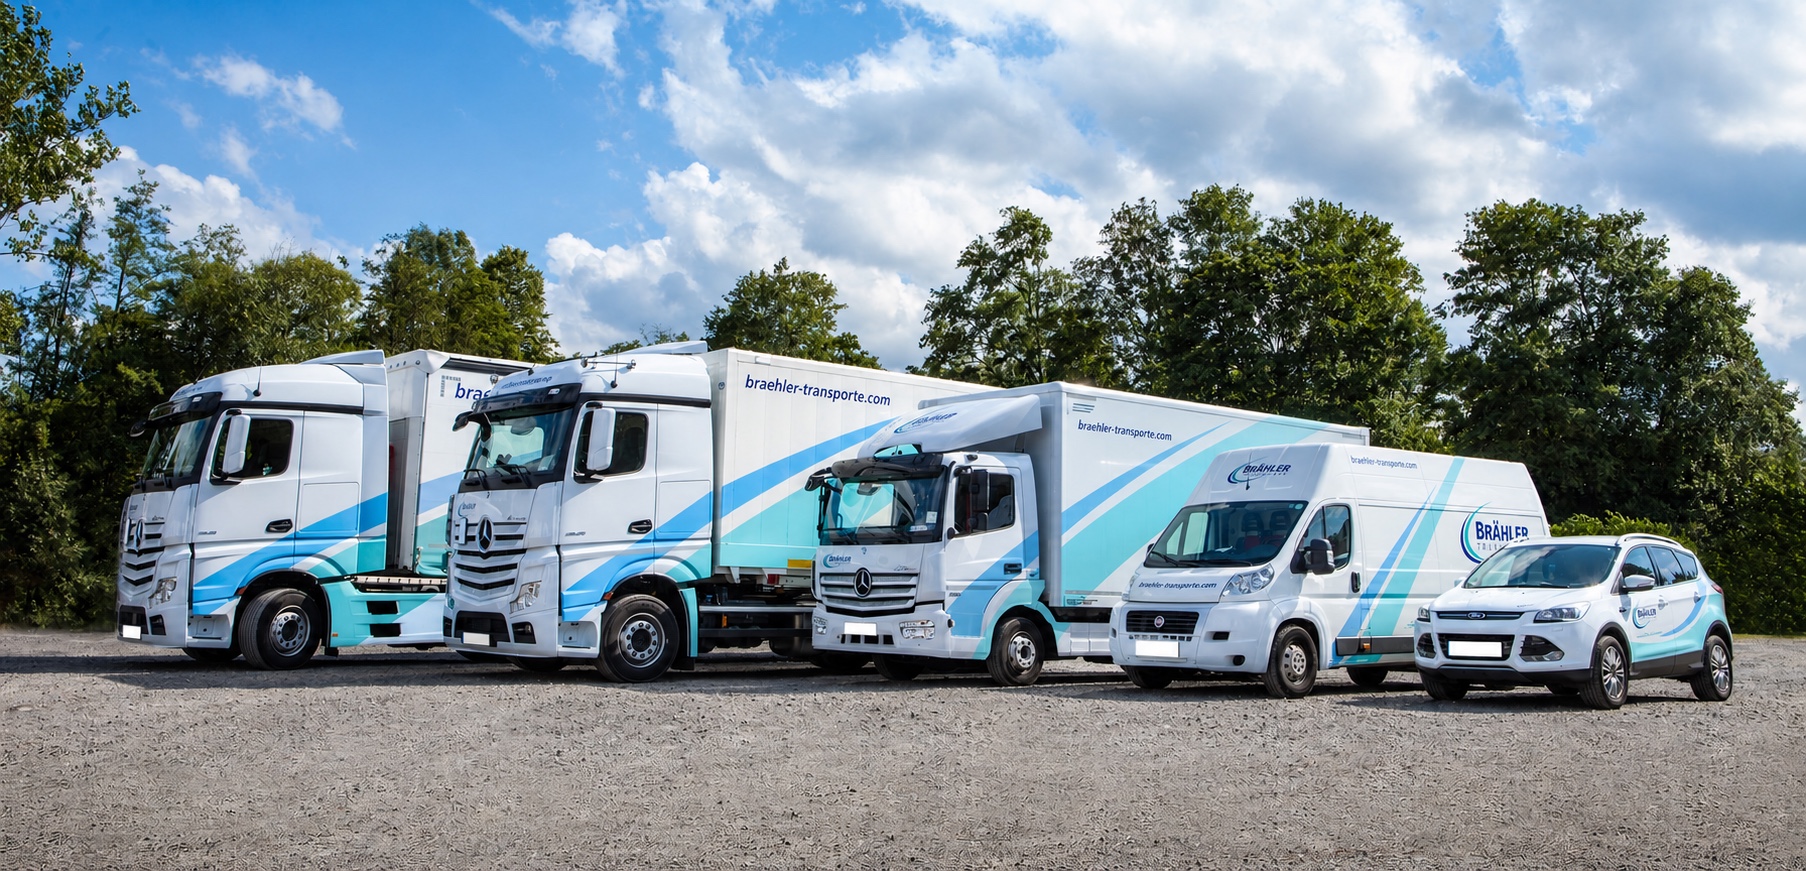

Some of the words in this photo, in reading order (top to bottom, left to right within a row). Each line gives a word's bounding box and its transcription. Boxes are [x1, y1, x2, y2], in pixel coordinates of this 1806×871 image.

[745, 374, 891, 406] braehler-transporte.com
[1078, 419, 1172, 441] braehler-transporte.com
[1243, 463, 1291, 474] BRÄHLER
[1350, 455, 1418, 469] braehler-transporte.com
[1475, 520, 1529, 541] BRÄHLER
[1139, 582, 1217, 590] braehler-transporte.com
